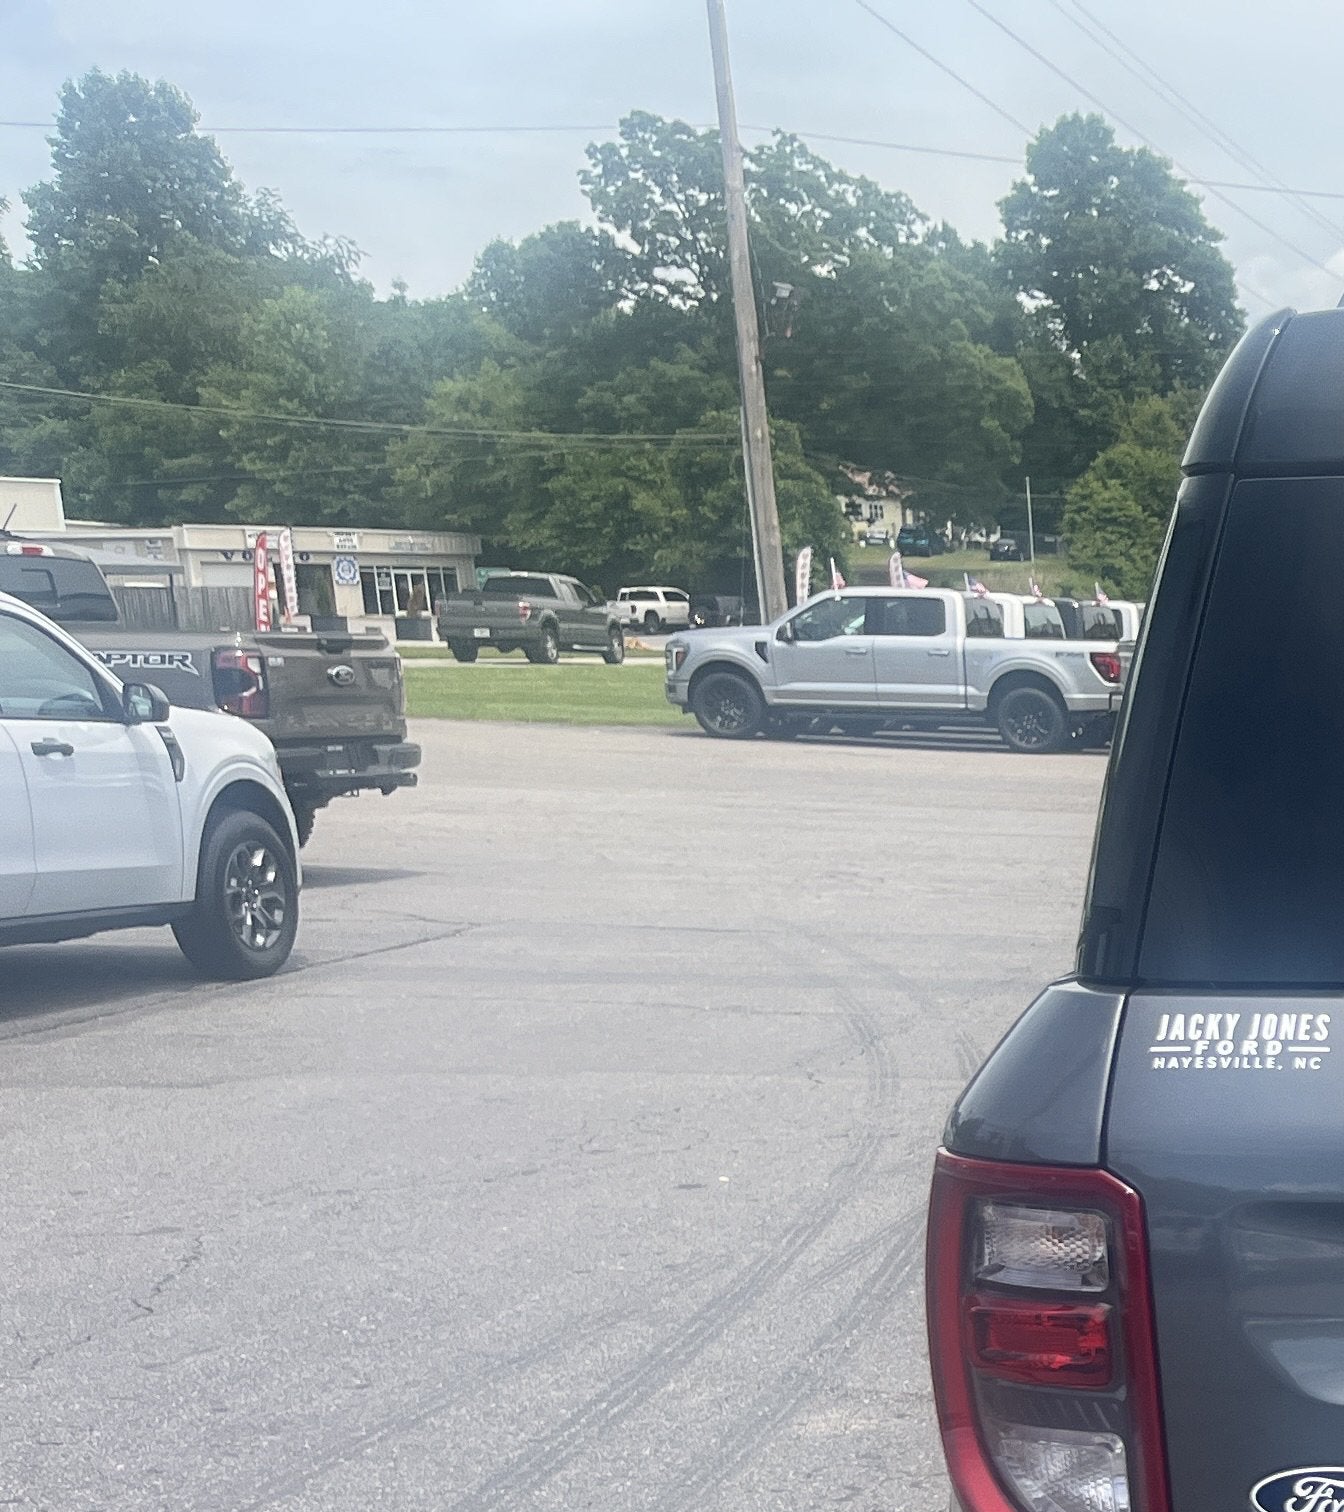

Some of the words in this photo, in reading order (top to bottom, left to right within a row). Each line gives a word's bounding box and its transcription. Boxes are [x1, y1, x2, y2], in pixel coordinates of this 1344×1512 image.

[92, 650, 201, 677] APTOR
[1155, 1013, 1241, 1041] JACKY
[1247, 1013, 1331, 1041] JONES
[1194, 1040, 1284, 1057] FORD
[1153, 1057, 1283, 1070] HAYESVILLE,
[1294, 1056, 1323, 1070] NC
